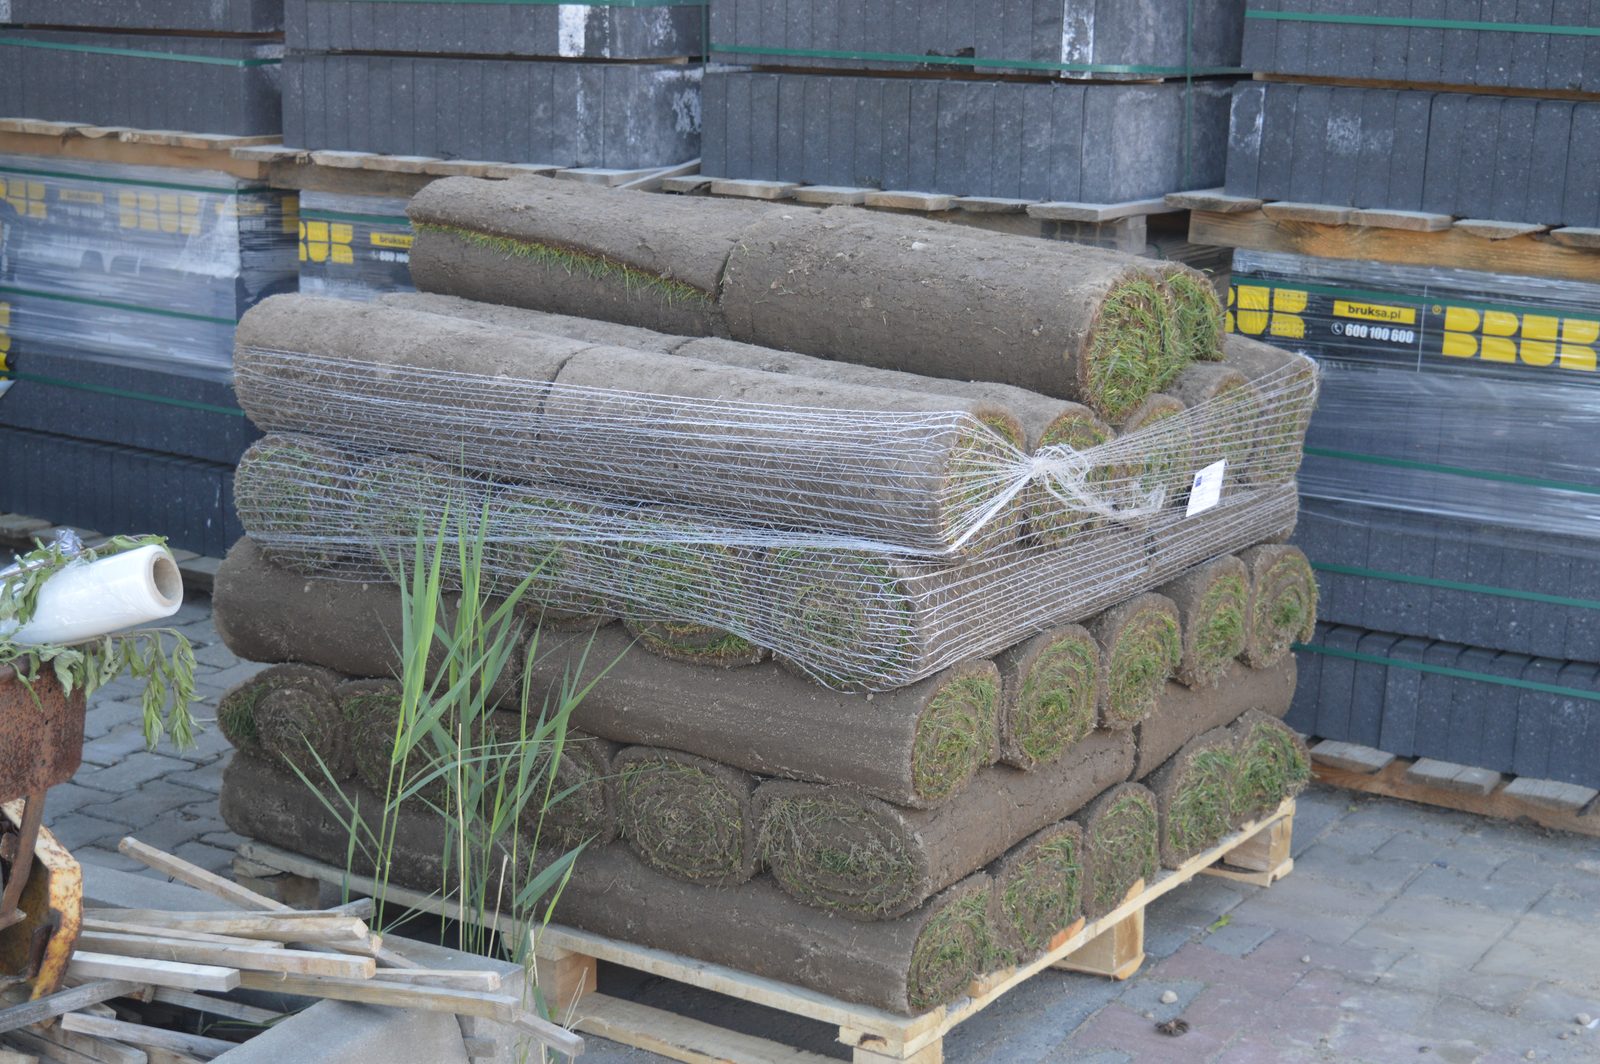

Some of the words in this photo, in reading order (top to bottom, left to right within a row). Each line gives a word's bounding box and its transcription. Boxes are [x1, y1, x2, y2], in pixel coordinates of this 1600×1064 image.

[1347, 304, 1402, 320] bruksa.pl
[1345, 323, 1368, 338] 600
[1369, 326, 1390, 341] 100
[1390, 329, 1414, 344] 600
[1442, 306, 1600, 372] BRUK
